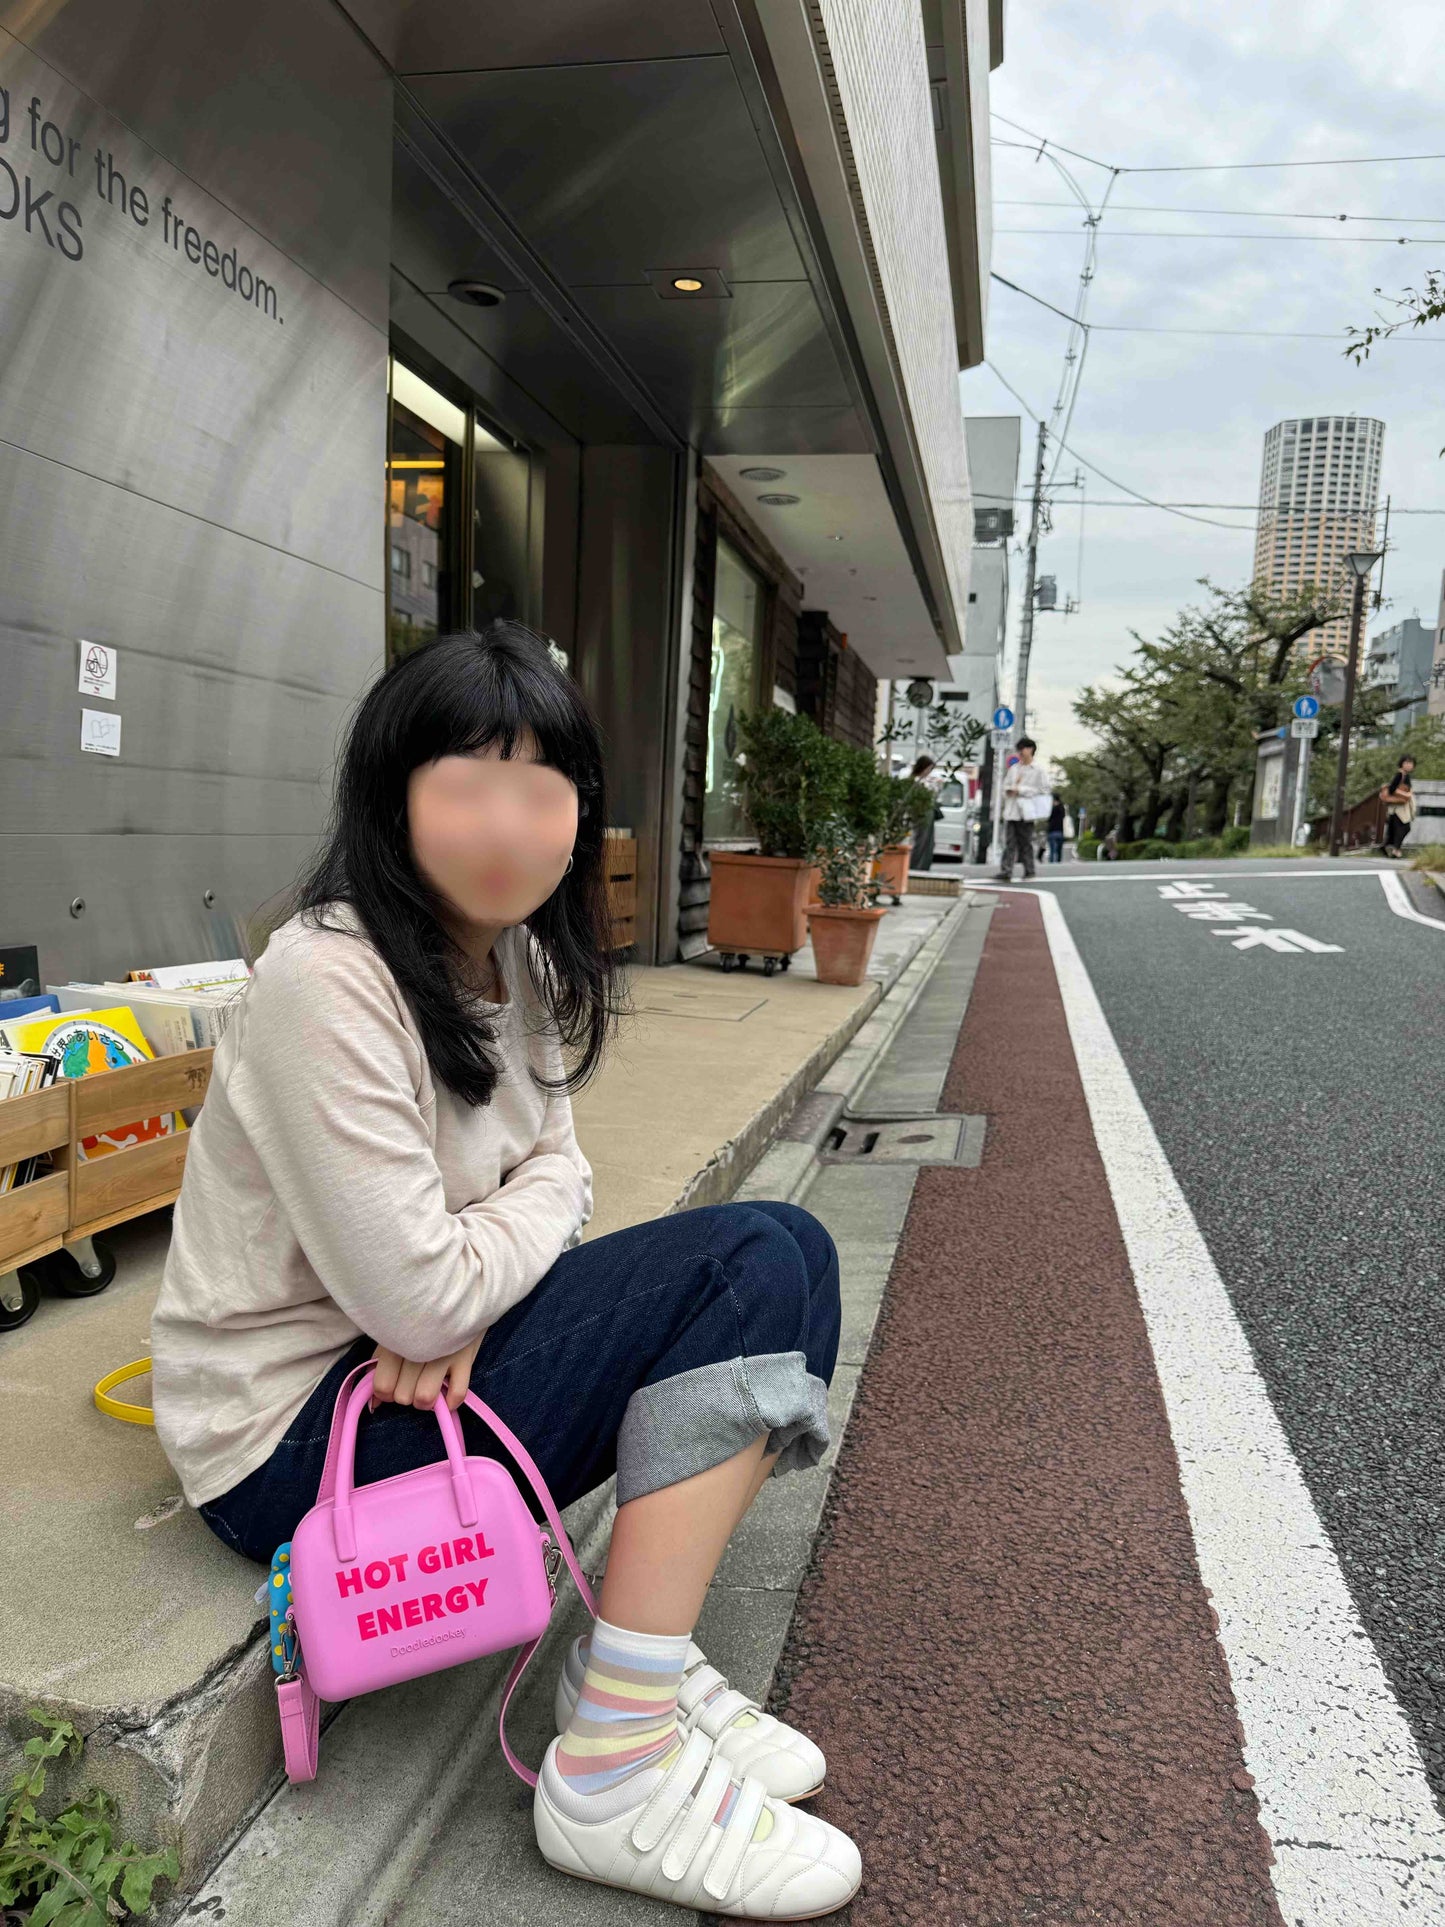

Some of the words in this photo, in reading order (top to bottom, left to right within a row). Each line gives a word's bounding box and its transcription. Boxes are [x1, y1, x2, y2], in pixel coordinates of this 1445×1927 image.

[28, 97, 81, 176] for
[94, 148, 149, 227] the
[162, 197, 283, 325] freedom.
[1157, 881, 1345, 952] 止まれ
[335, 1554, 409, 1598] HOT
[417, 1532, 495, 1574] GIRL
[356, 1578, 489, 1641] ENERGY
[390, 1628, 466, 1658] Doodledookey
